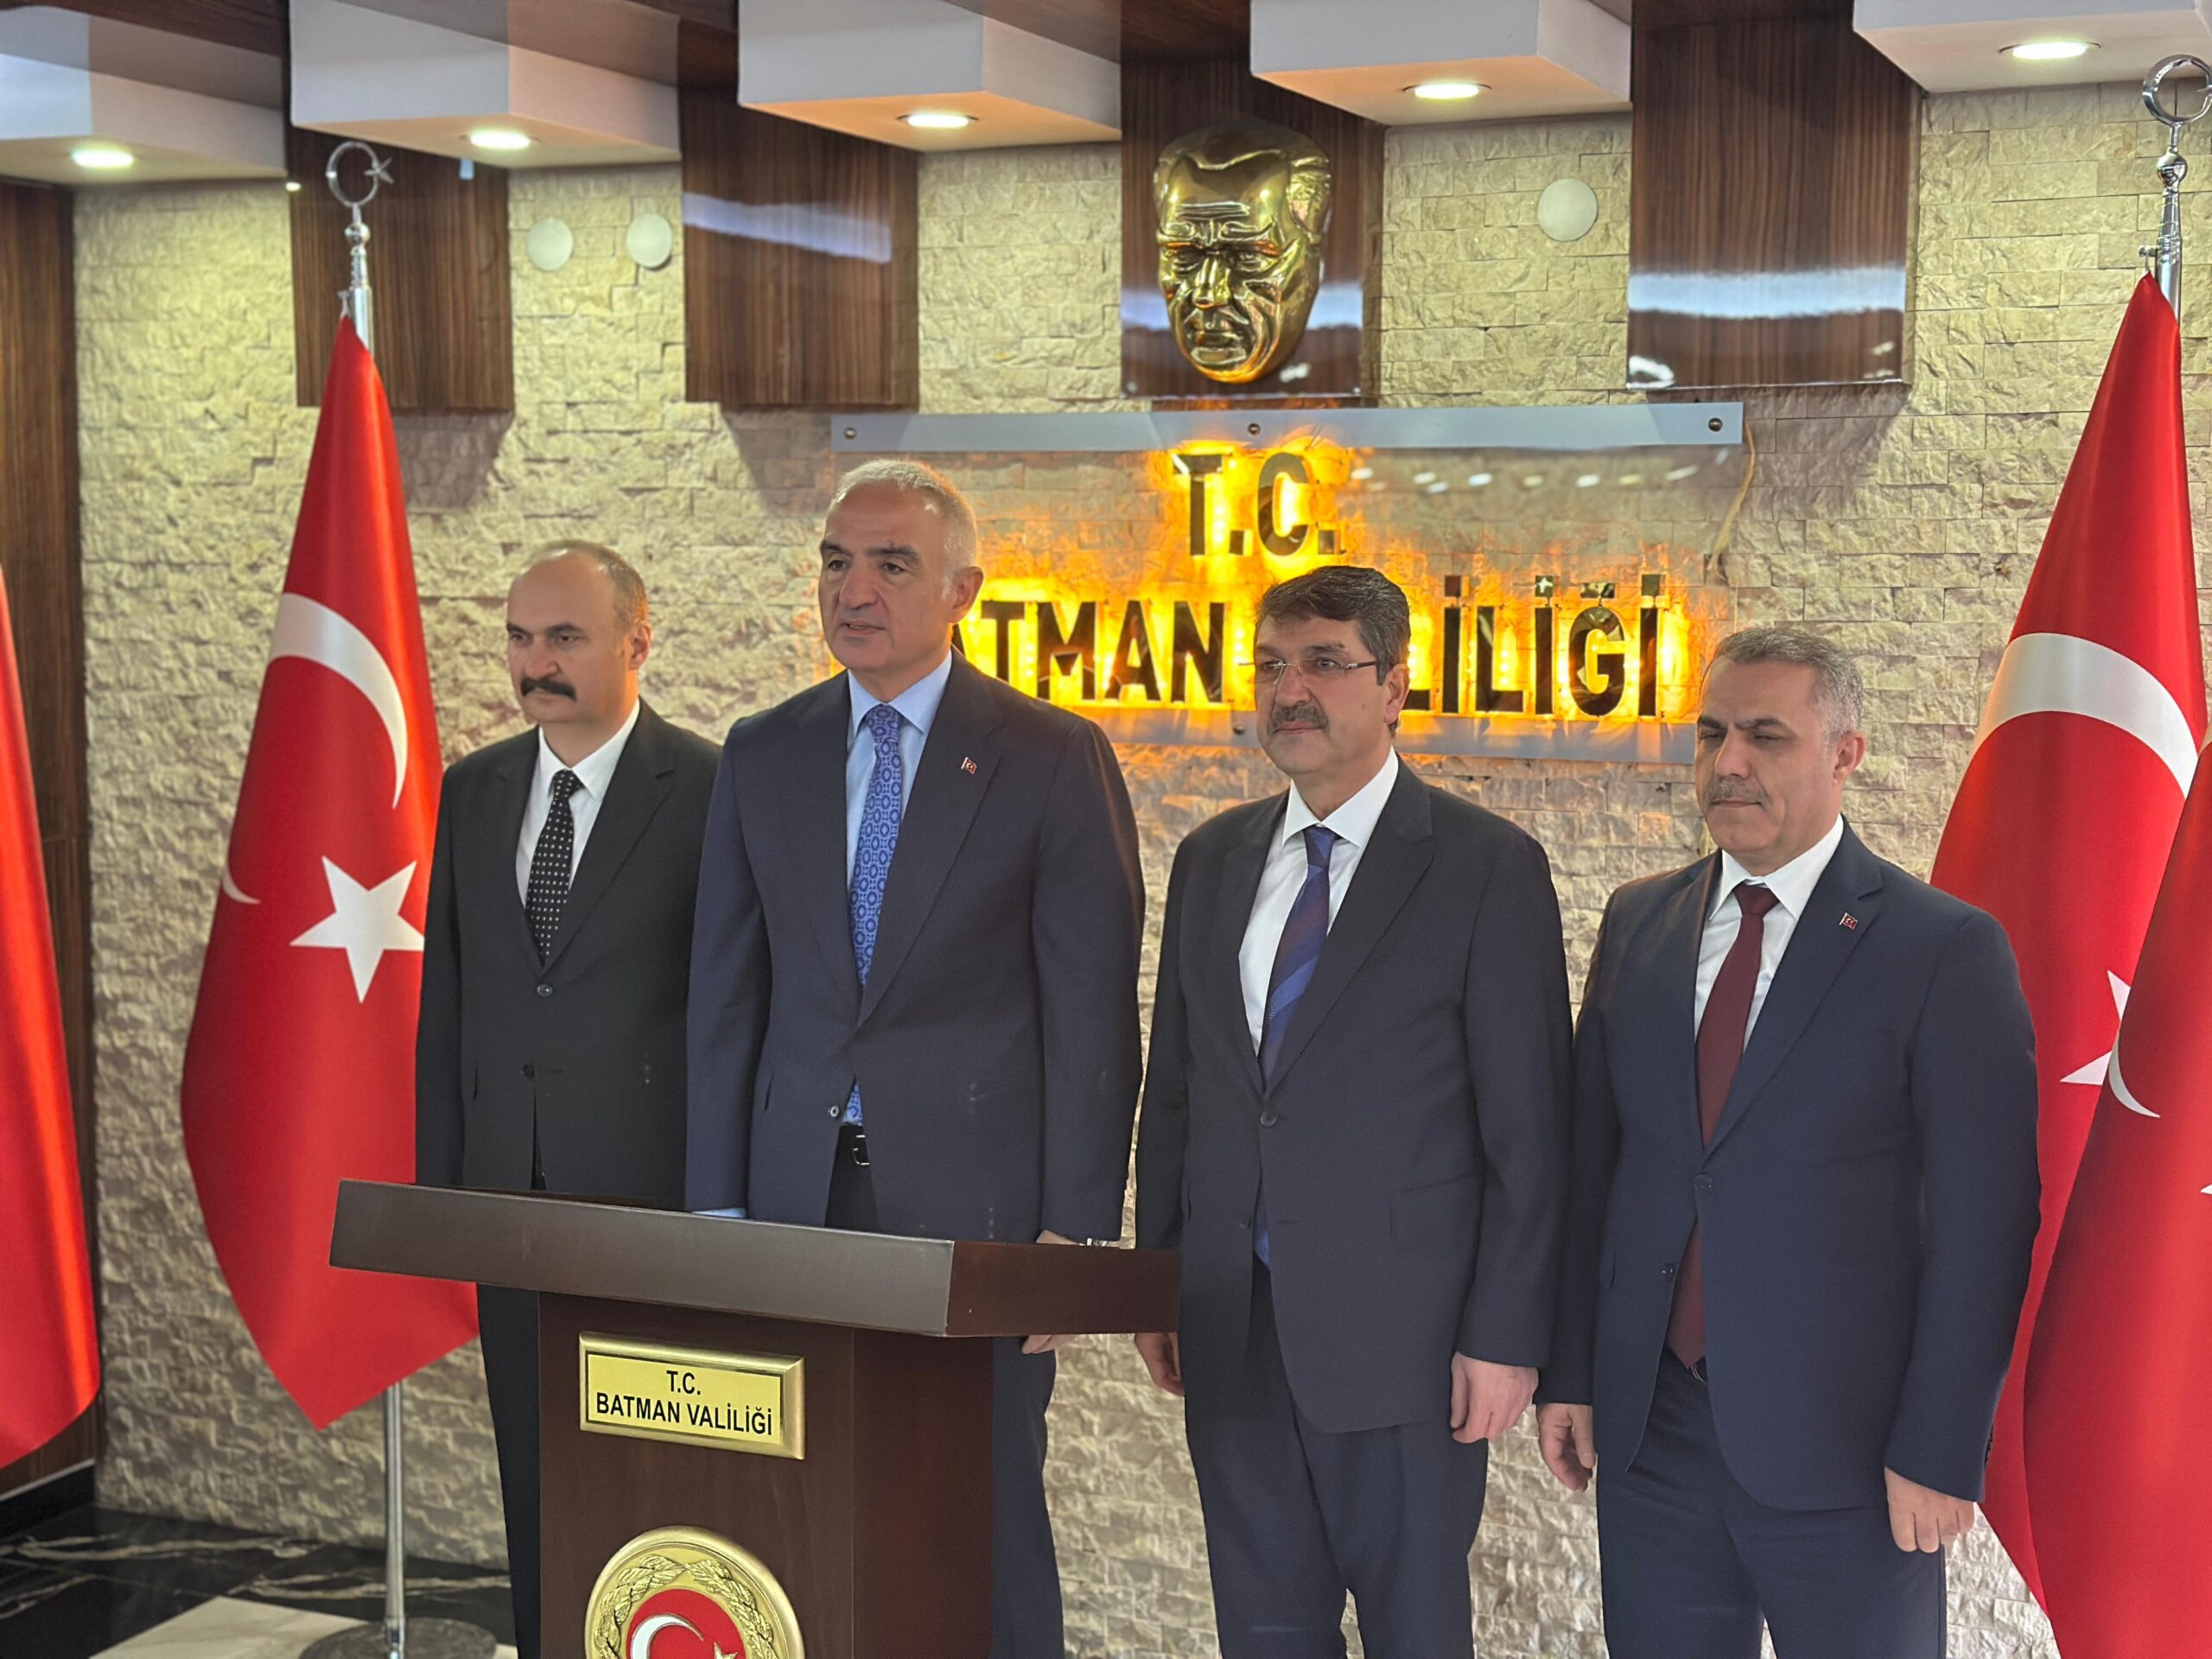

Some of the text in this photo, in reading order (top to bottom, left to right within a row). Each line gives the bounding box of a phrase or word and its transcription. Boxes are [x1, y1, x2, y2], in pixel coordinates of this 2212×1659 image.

[1173, 451, 1337, 556] T.C.
[951, 574, 1667, 717] TMAN İLİĞİ
[596, 1392, 772, 1435] BATMAN VALİLİĞİ
[666, 1370, 702, 1395] T.C.
